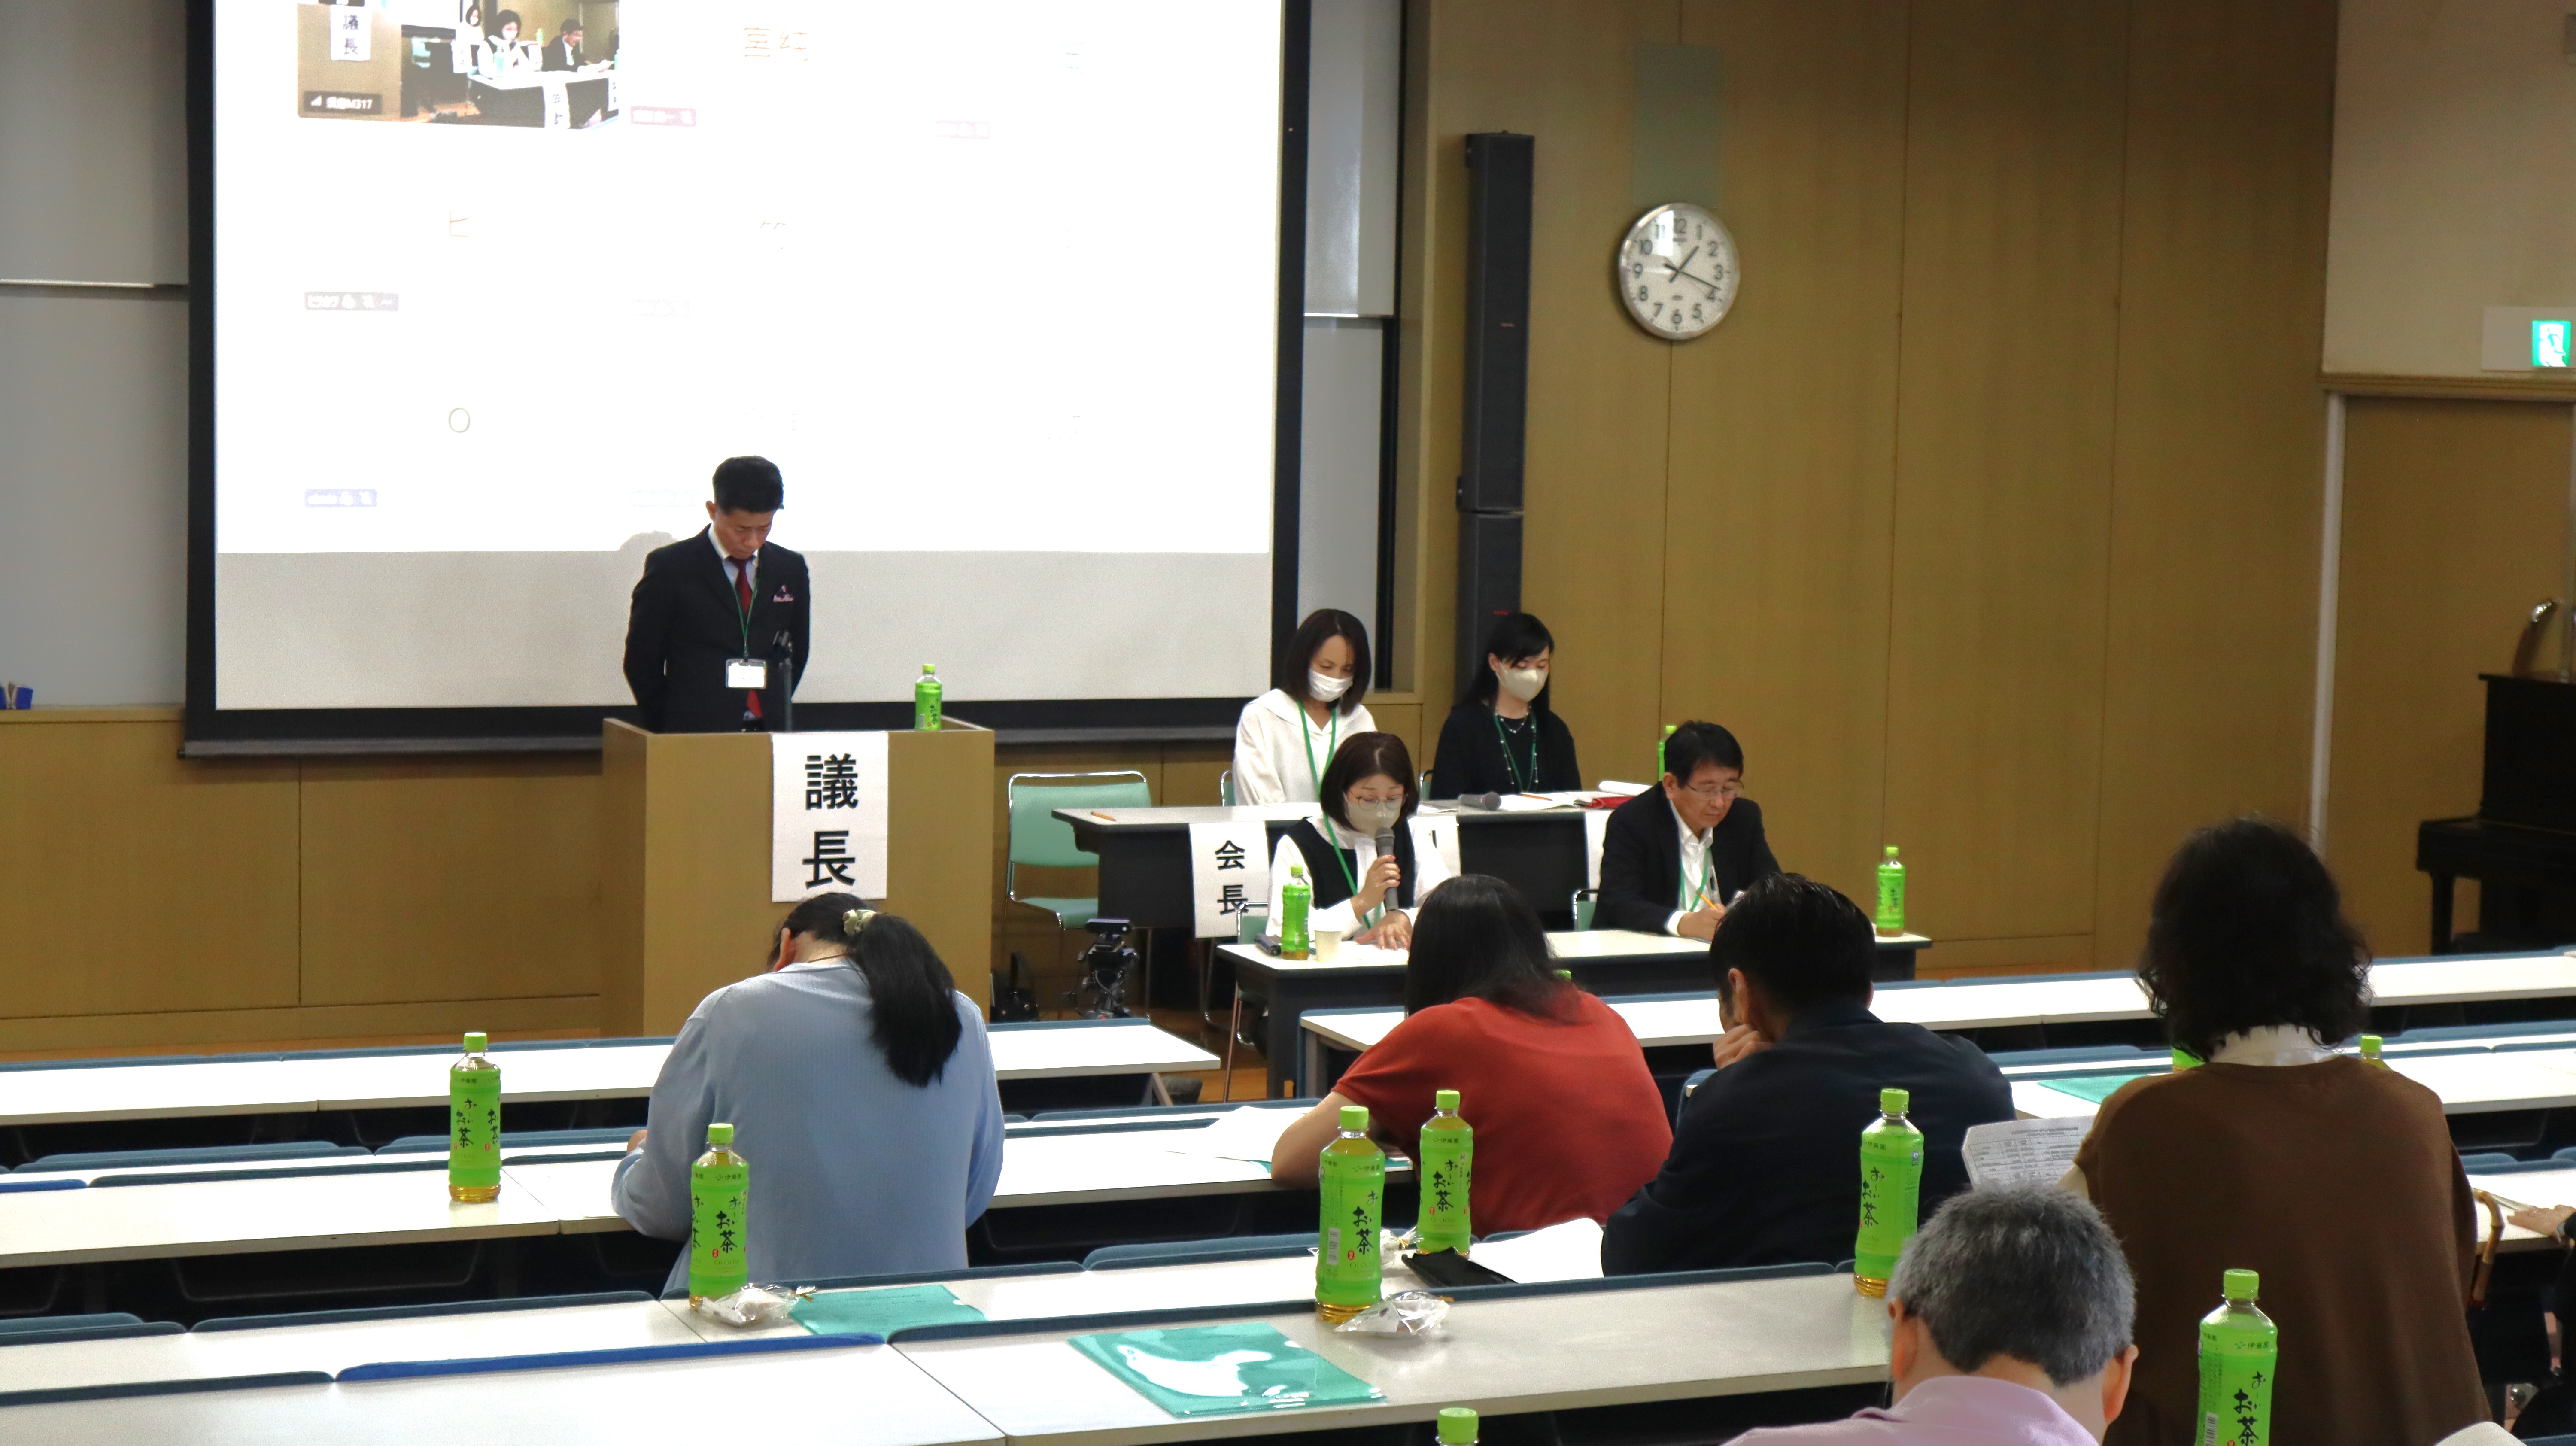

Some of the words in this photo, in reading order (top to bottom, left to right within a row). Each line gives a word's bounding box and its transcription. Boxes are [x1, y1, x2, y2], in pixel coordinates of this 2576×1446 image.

[1674, 218, 1687, 234] 12
[1697, 224, 1702, 240] 1
[1639, 240, 1653, 255] 10
[1708, 241, 1717, 256] 2
[1633, 263, 1643, 279] 9
[1714, 264, 1723, 280] 3
[1638, 286, 1648, 301] 8
[1707, 288, 1716, 300] 4
[1654, 302, 1663, 317] 7
[1672, 308, 1682, 324] 6
[1692, 303, 1702, 319] 5
[802, 753, 858, 889] 議長
[1215, 840, 1248, 915] 会長
[456, 1109, 474, 1148] お茶
[1433, 1171, 1454, 1212] お茶
[1862, 1179, 1879, 1227] お茶
[716, 1211, 738, 1254] お茶
[1353, 1206, 1373, 1255] お茶
[2233, 1388, 2260, 1446] お茶
